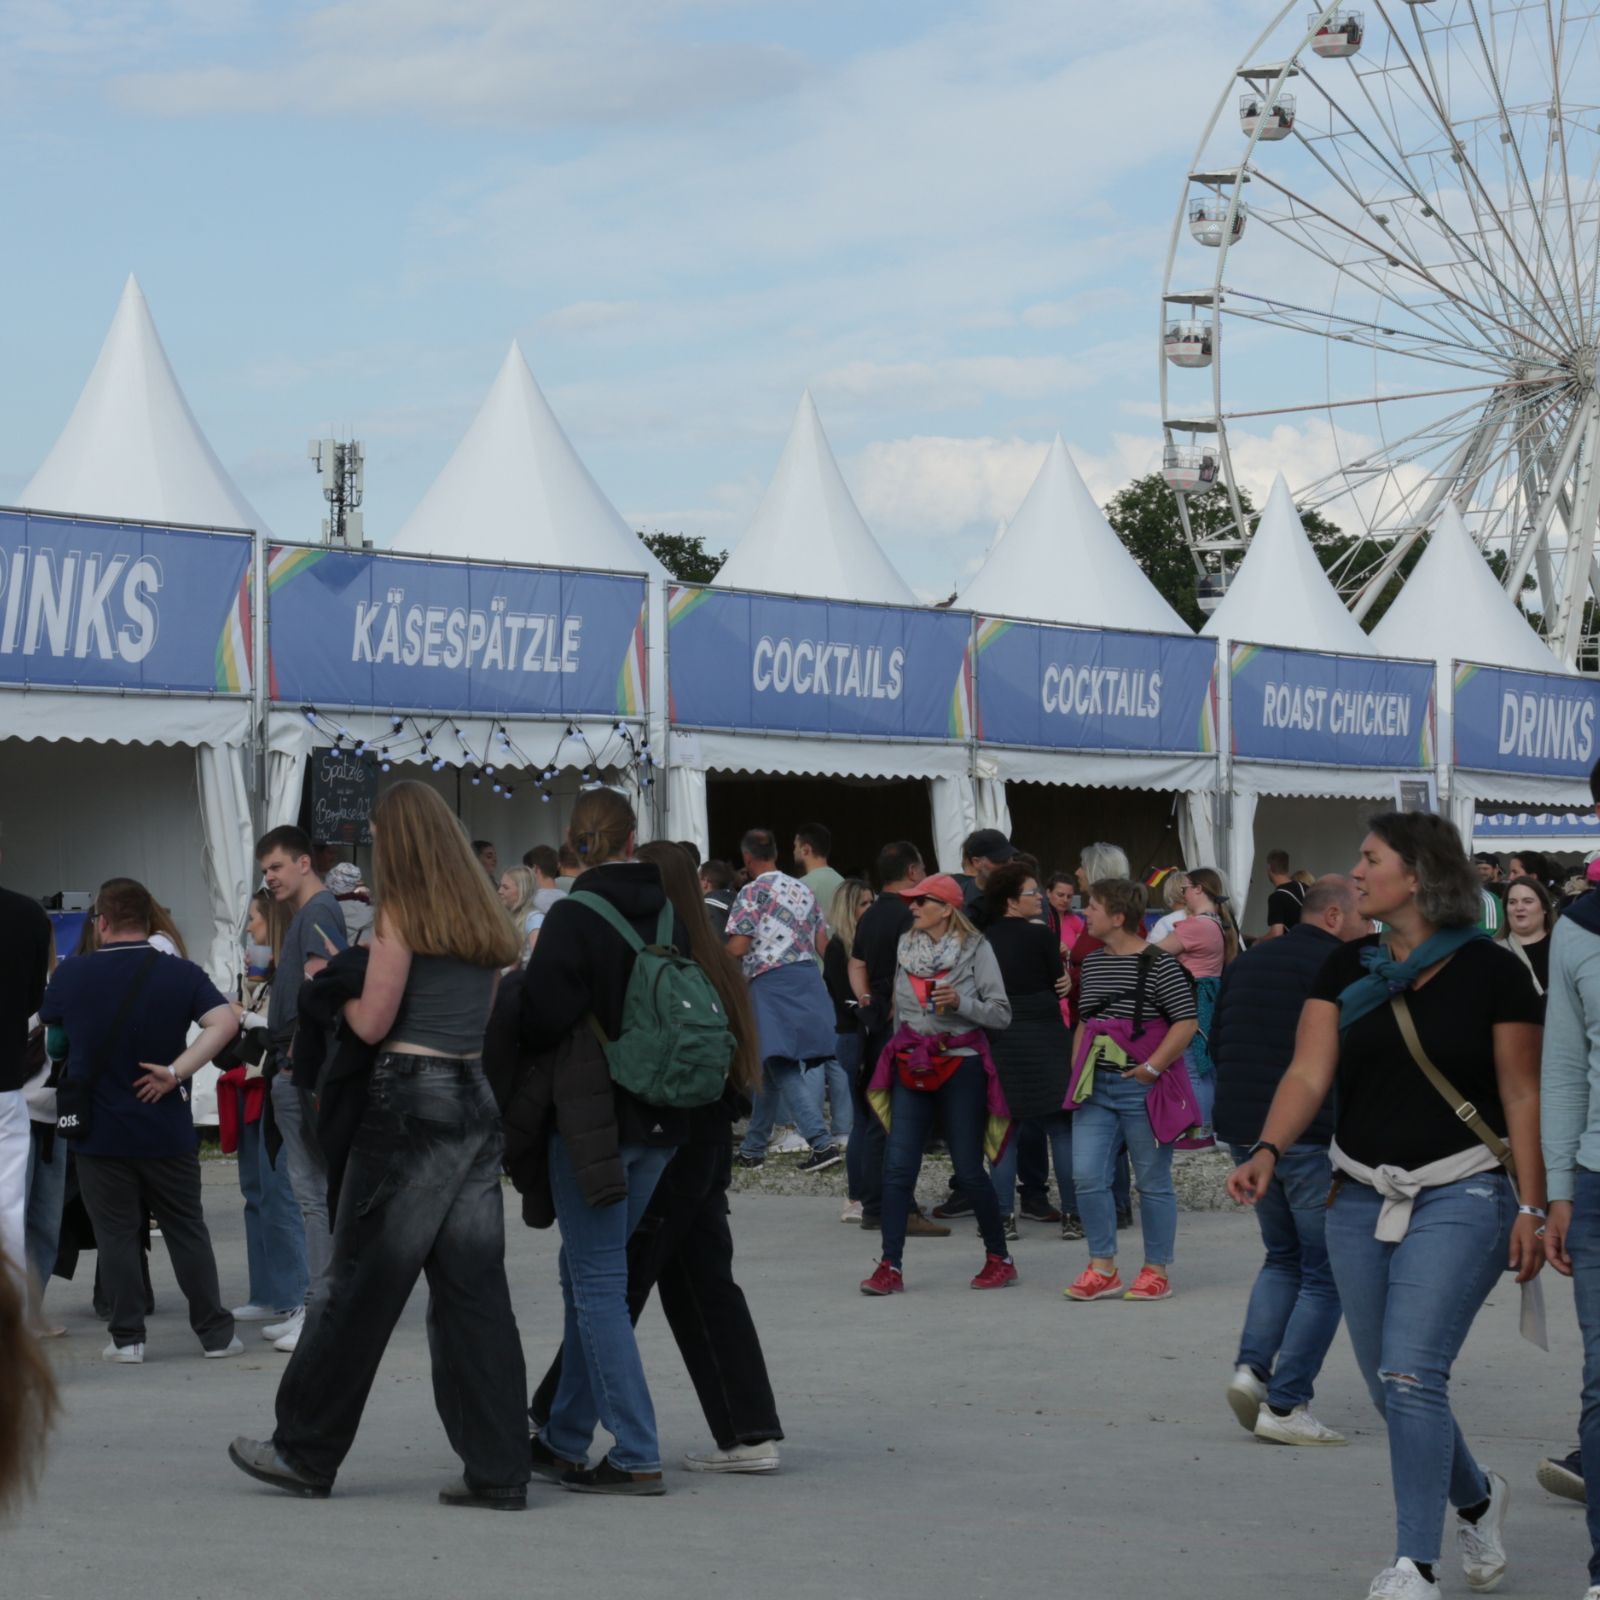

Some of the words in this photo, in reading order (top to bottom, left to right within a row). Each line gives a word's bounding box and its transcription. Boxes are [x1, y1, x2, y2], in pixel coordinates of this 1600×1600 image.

[0, 545, 164, 664] INKS
[352, 588, 583, 673] KÄSESPÄTZLE
[752, 635, 905, 701] COCKTAILS
[1042, 662, 1163, 719] COCKTAILS
[1262, 681, 1328, 732] ROAST
[1329, 688, 1412, 737] CHICKEN
[1498, 688, 1596, 763] DRINKS
[57, 1114, 80, 1129] OSS.
